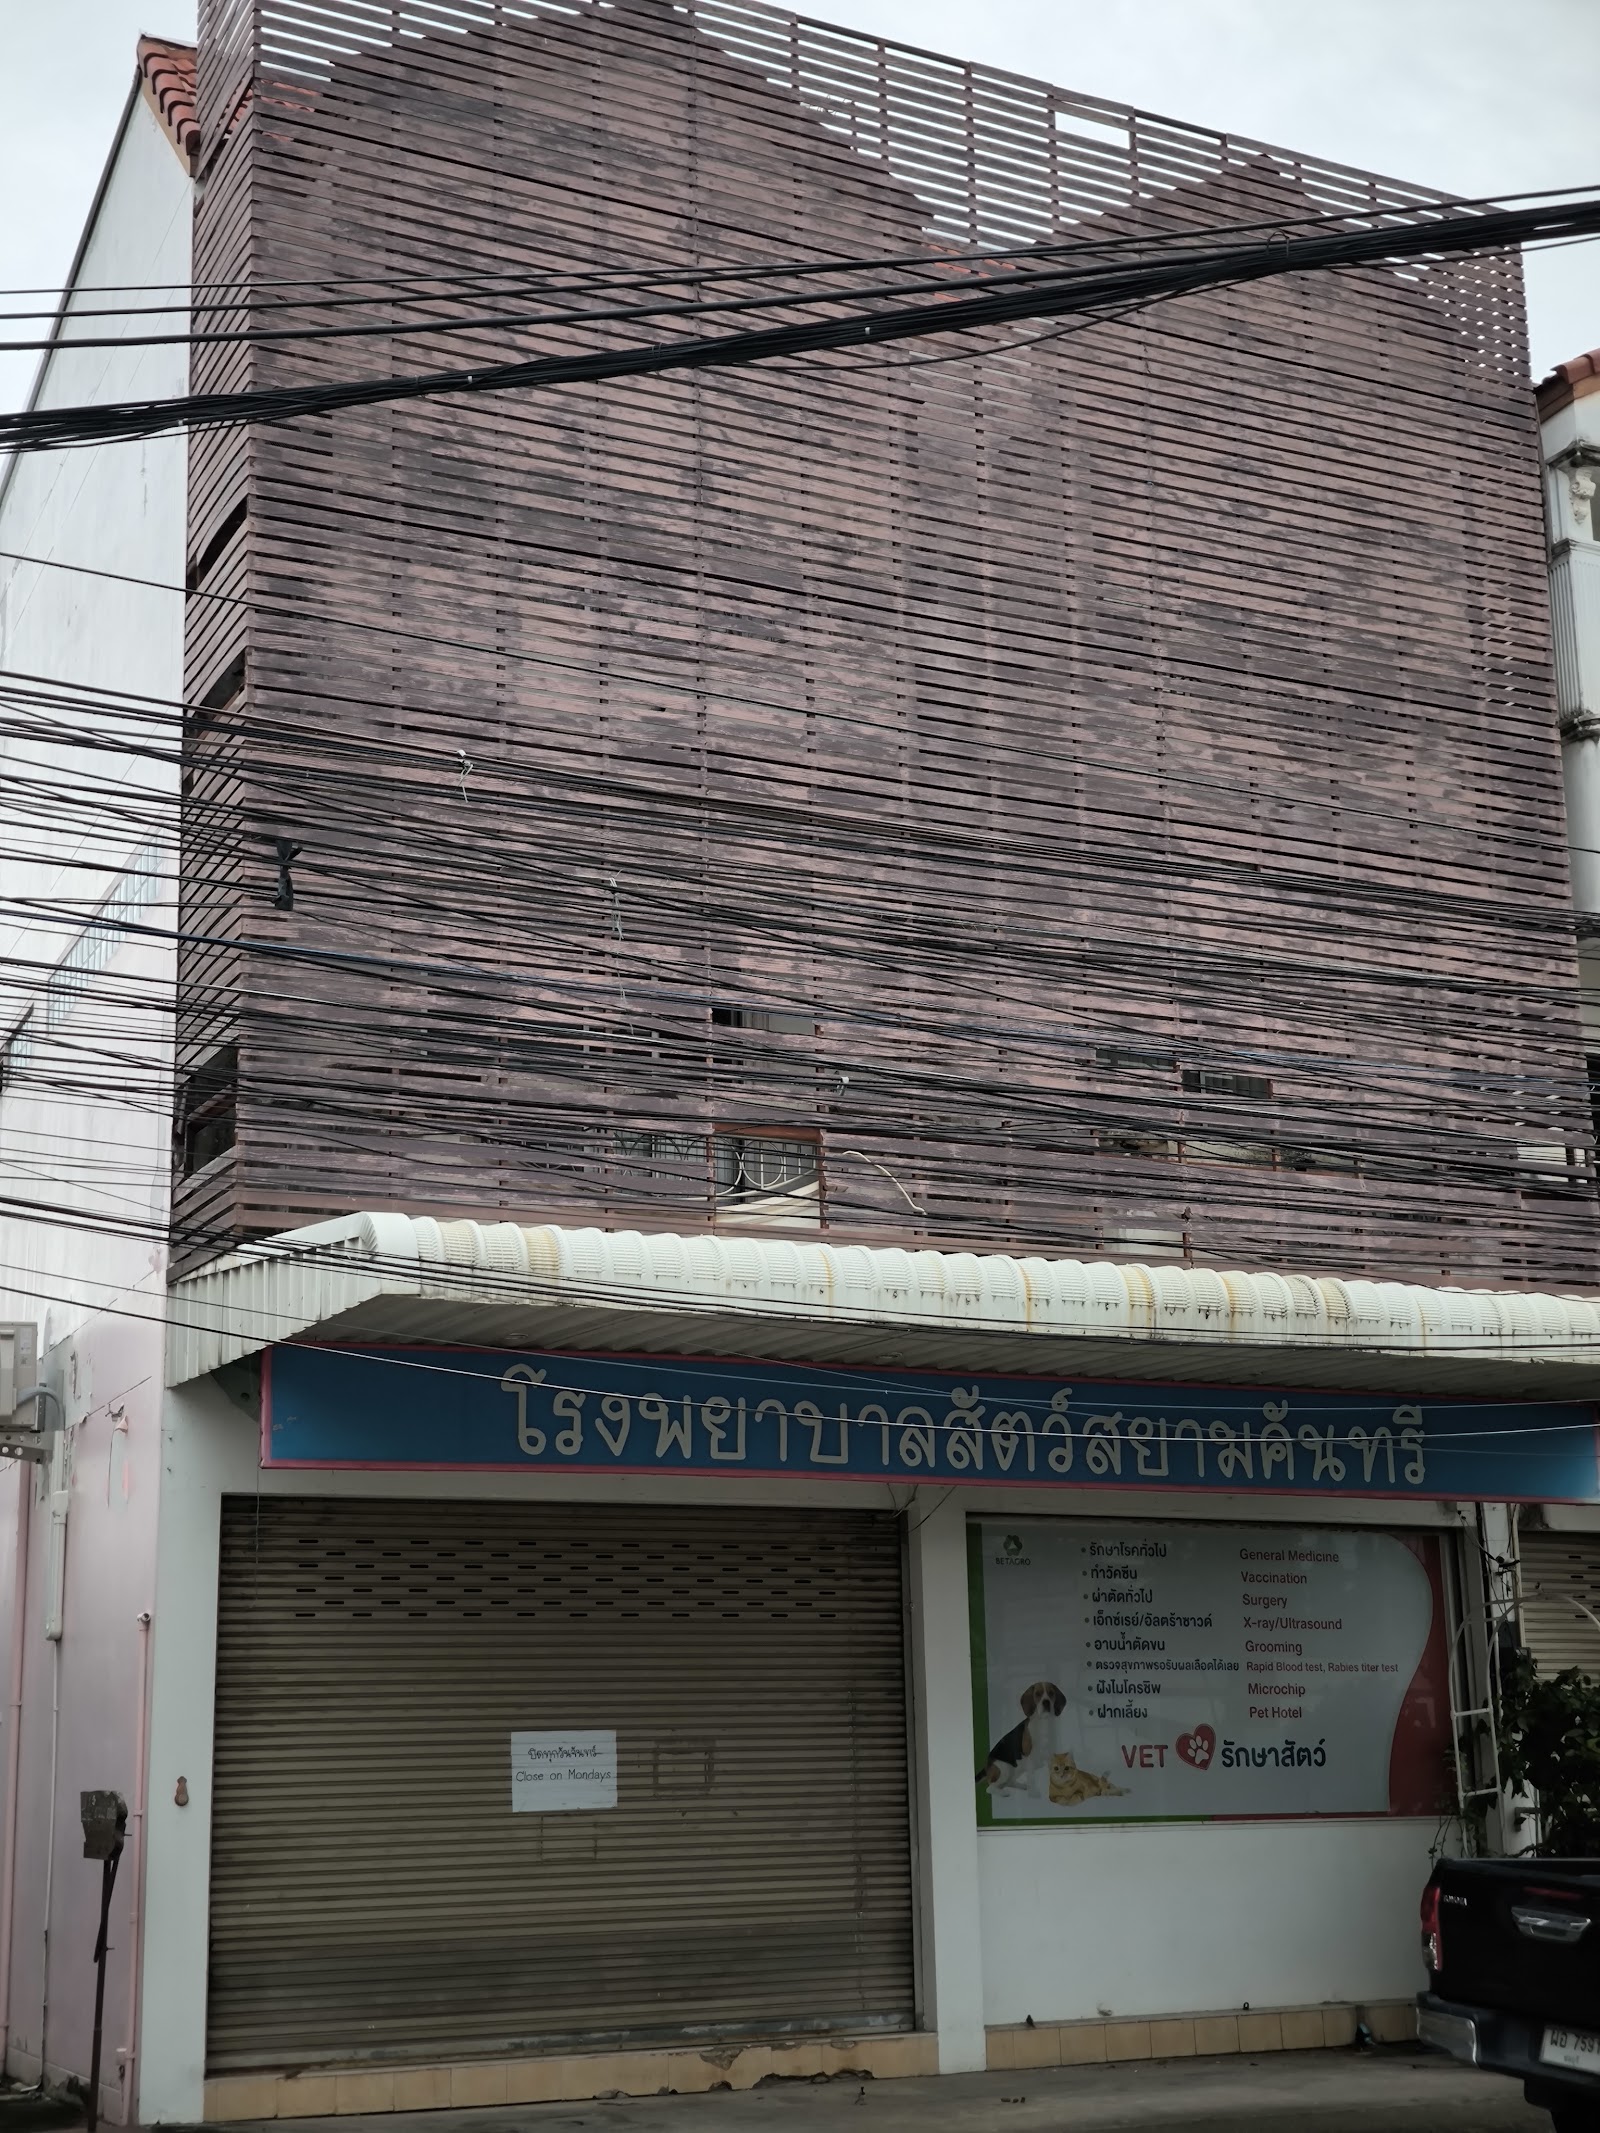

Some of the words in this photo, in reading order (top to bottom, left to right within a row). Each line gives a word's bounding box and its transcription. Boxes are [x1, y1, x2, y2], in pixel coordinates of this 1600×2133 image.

[501, 1363, 1425, 1485] โรงพยาบาลสัตว์สยามคันทรี
[1089, 1538, 1168, 1558] รักษาโรคทั่วไป
[1239, 1548, 1285, 1561] General
[1288, 1550, 1340, 1563] Medicine
[995, 1557, 1031, 1566] BETAGRO
[1090, 1563, 1138, 1580] ทำวัคซีน
[1240, 1571, 1308, 1584] Vaccination
[1092, 1584, 1153, 1603] ผ่าตัดทั่วไป
[1242, 1593, 1288, 1609] Surgery
[1093, 1609, 1213, 1628] เอ็กซ์เรย์/อัลตร้าซาวด์
[1243, 1616, 1342, 1632] X-ray/Ultrasound
[1094, 1631, 1166, 1651] อาบน้ำตัดขน
[1245, 1640, 1303, 1656] Grooming
[1095, 1658, 1240, 1674] ตรวจสุขภาพรอรับผลเลือดได้เลย
[1246, 1661, 1274, 1674] Rapid
[1276, 1661, 1303, 1672] Blood
[1305, 1662, 1326, 1673] test,
[1328, 1662, 1359, 1672] Rabies
[1361, 1662, 1379, 1672] titer
[1381, 1663, 1399, 1672] test
[1096, 1679, 1162, 1695] ฝังไมโครชิพ
[1248, 1682, 1306, 1698] Microchip
[1097, 1699, 1149, 1719] ฝากเลี้ยง
[1249, 1706, 1269, 1719] Pet
[1271, 1706, 1302, 1719] Hotel
[528, 1745, 599, 1763] ปิดทุกวันจันทร์
[1121, 1744, 1168, 1768] VET
[1221, 1738, 1327, 1768] รักษาสัตว์
[515, 1770, 544, 1782] Close
[549, 1772, 563, 1780] on
[568, 1769, 612, 1783] Mondays
